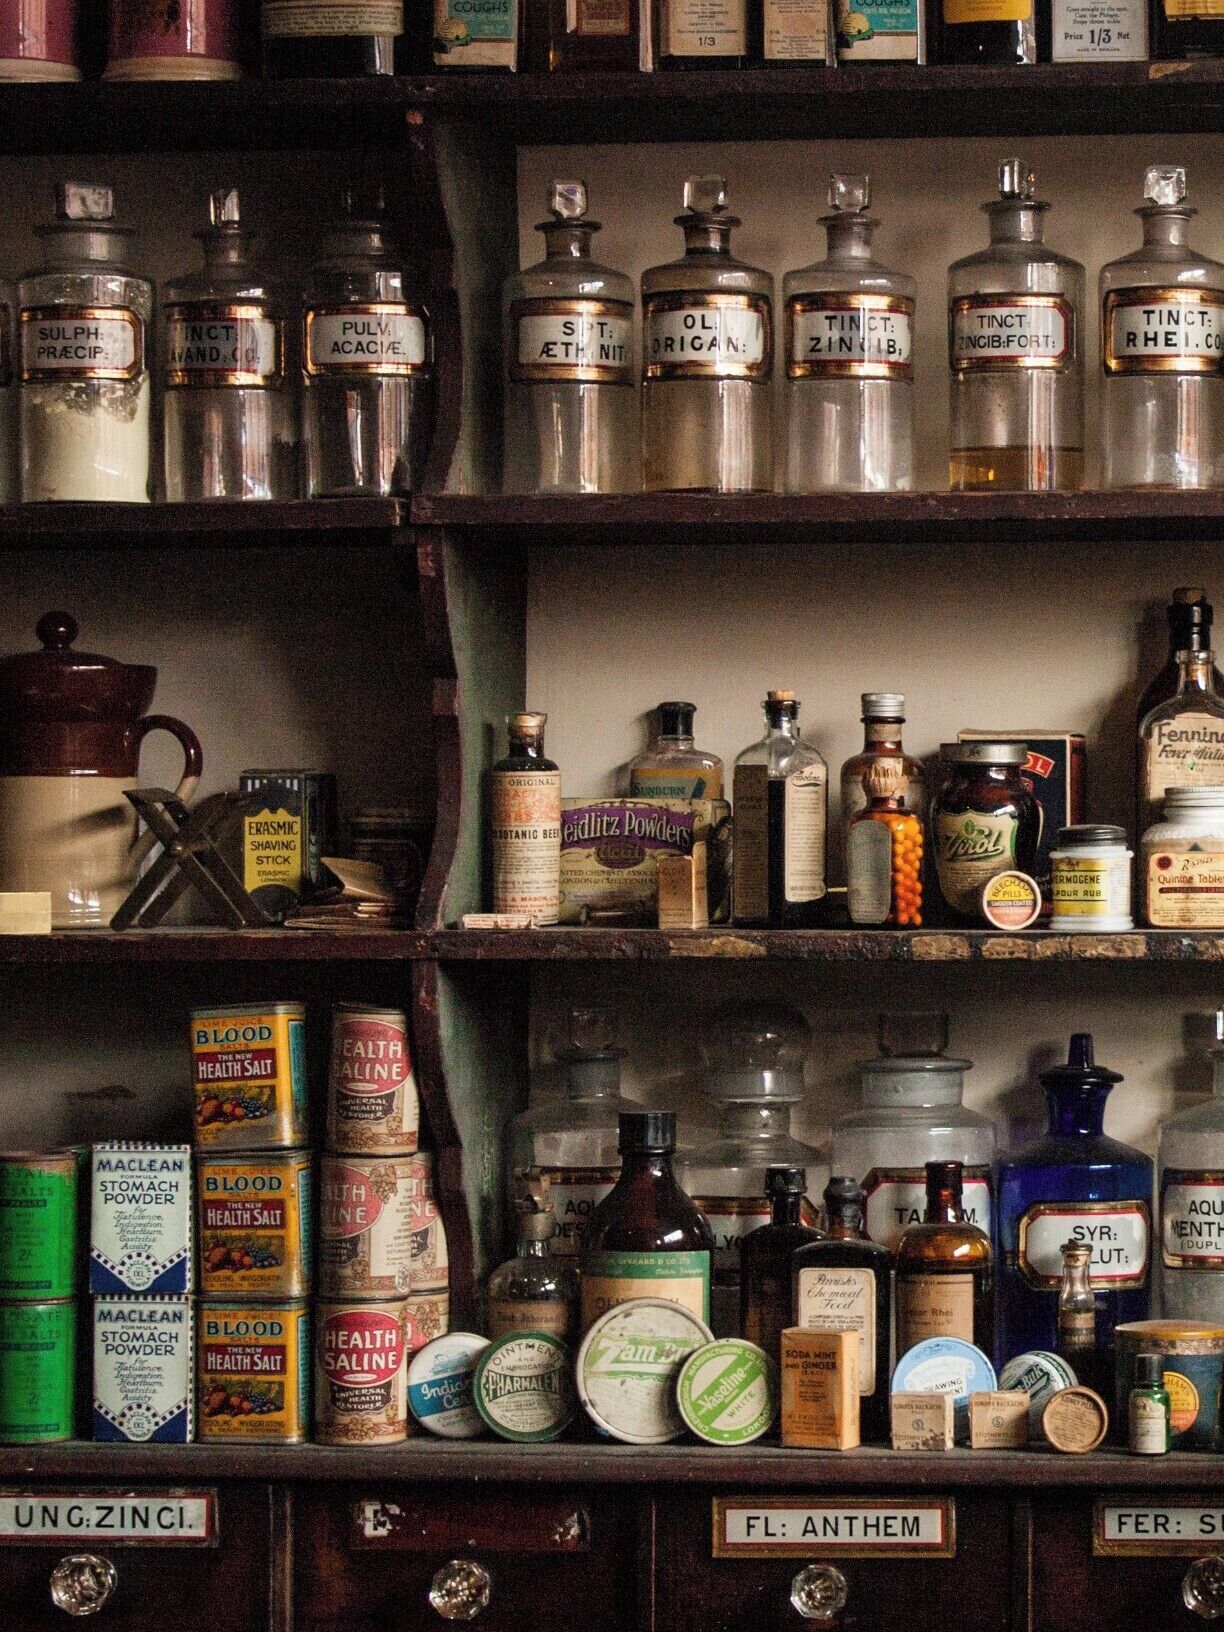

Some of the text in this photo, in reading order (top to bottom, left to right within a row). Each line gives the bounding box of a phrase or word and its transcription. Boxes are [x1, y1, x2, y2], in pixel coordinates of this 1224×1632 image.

[699, 37, 716, 46] 1/3
[1064, 29, 1130, 46] Price 1/3 Net
[824, 315, 895, 335] TINCT:
[976, 314, 1031, 329] TINCT:
[1143, 310, 1213, 328] TINCT:
[38, 326, 104, 341] SULPH:
[177, 324, 239, 342] INCT:
[342, 321, 392, 337] PULV:
[248, 820, 299, 836] ERASMIC
[561, 811, 691, 847] eidlitz Powders
[250, 840, 296, 851] SHAVING
[255, 855, 291, 865] STICK
[1158, 874, 1194, 884] Quinine
[1002, 890, 1022, 898] PILLS
[1083, 889, 1101, 897] RUB
[196, 1026, 272, 1045] BLOOD
[341, 1040, 402, 1058] EALTH
[199, 1060, 273, 1079] HEALTH SALT
[341, 1062, 402, 1080] ALINE
[97, 1159, 184, 1172] MACLEAN
[100, 1181, 179, 1193] STOMACH
[205, 1176, 282, 1192] BLOOD
[104, 1194, 175, 1205] POWDER
[134, 1206, 147, 1214] for
[207, 1209, 282, 1226] HEALTH SALT
[1073, 1225, 1118, 1242] SYR:
[1091, 1249, 1129, 1265] LUT:
[822, 1298, 855, 1310] Food
[98, 1310, 184, 1323] MACLEAN
[101, 1331, 179, 1343] STOMACH
[206, 1321, 283, 1337] BLOOD
[325, 1329, 397, 1349] HEALTH
[105, 1344, 175, 1356] POWDER
[785, 1350, 836, 1359] SODA MINT
[134, 1357, 147, 1365] for
[207, 1354, 283, 1371] HEALTH SALT
[324, 1351, 397, 1370] SALINE
[802, 1361, 837, 1370] GINGER
[698, 1366, 748, 1410] Vaseline
[727, 1391, 756, 1417] WHITE
[746, 1515, 921, 1538] FL: ANTHEM
[1117, 1513, 1183, 1534] FER:
